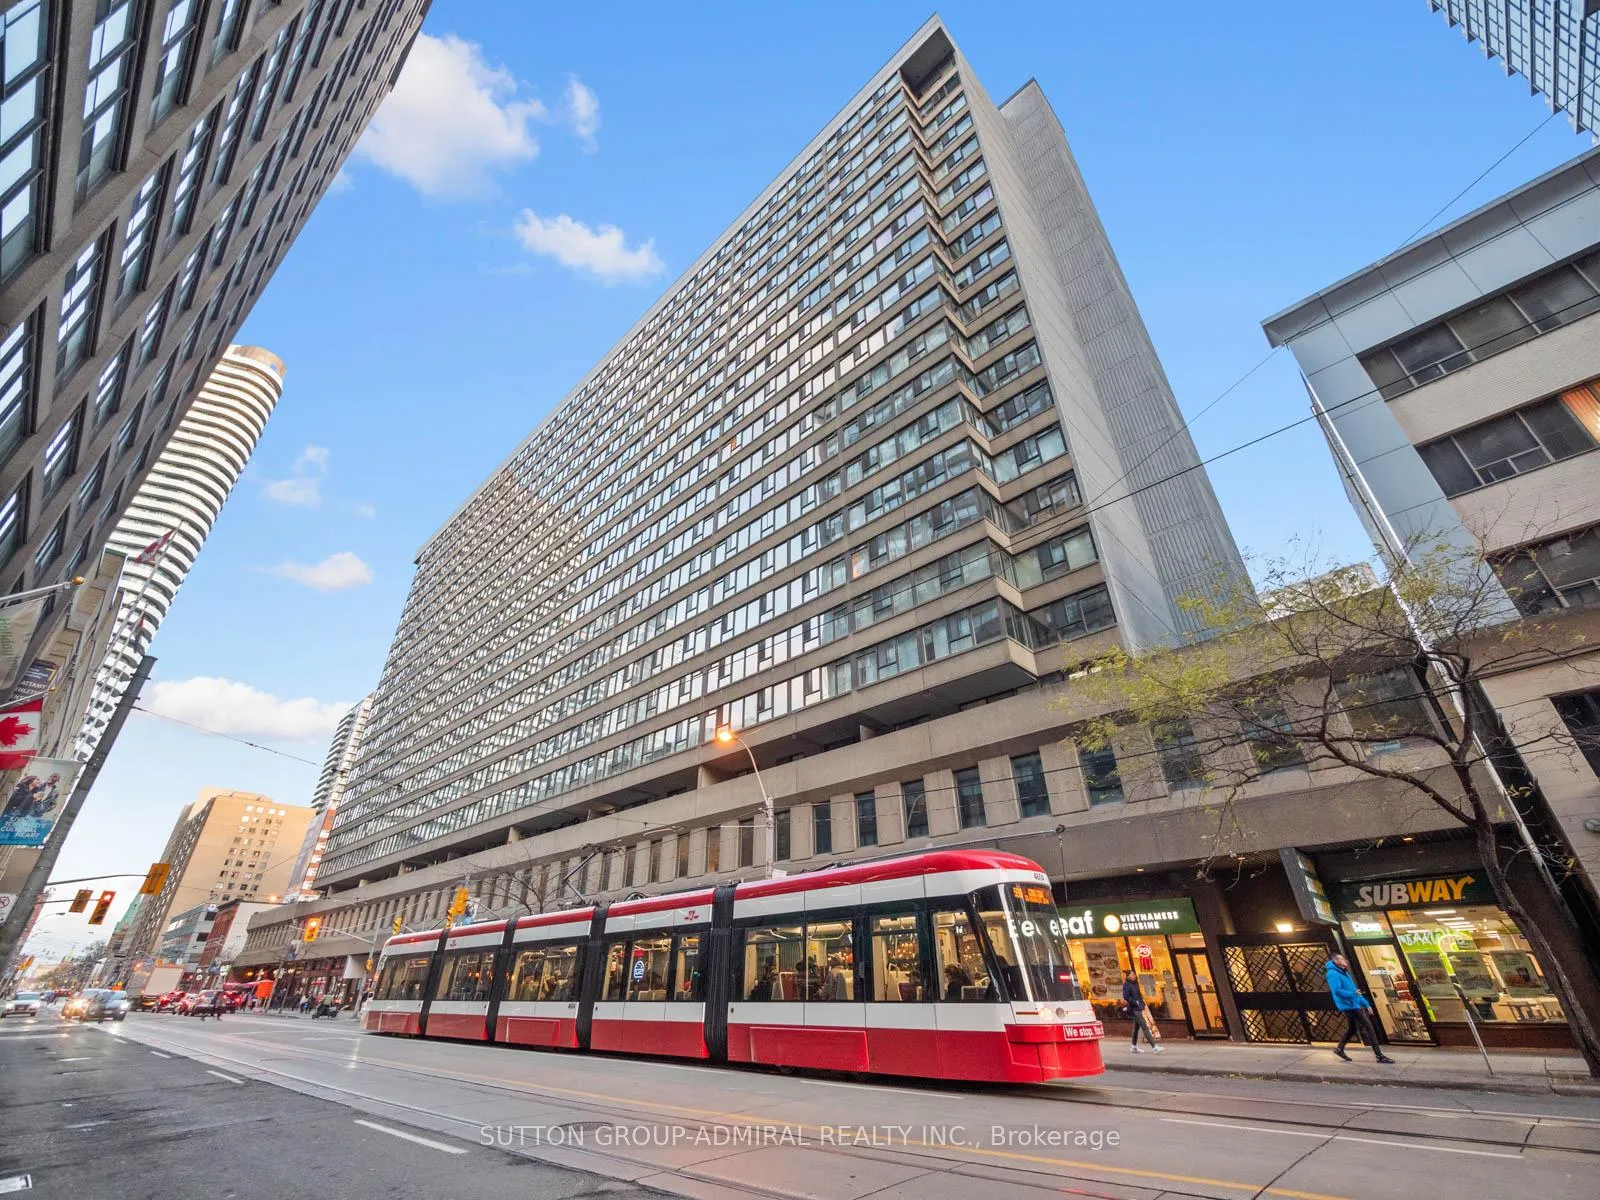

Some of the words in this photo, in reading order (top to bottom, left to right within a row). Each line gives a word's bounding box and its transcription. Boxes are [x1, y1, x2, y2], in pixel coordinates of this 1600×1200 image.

[1353, 876, 1475, 908] SUBWAY
[1059, 910, 1094, 935] eaf
[1120, 911, 1179, 923] VIETNAMESE
[1122, 921, 1160, 931] CUISINE
[1065, 1026, 1078, 1037] We
[1079, 1026, 1094, 1038] stop.
